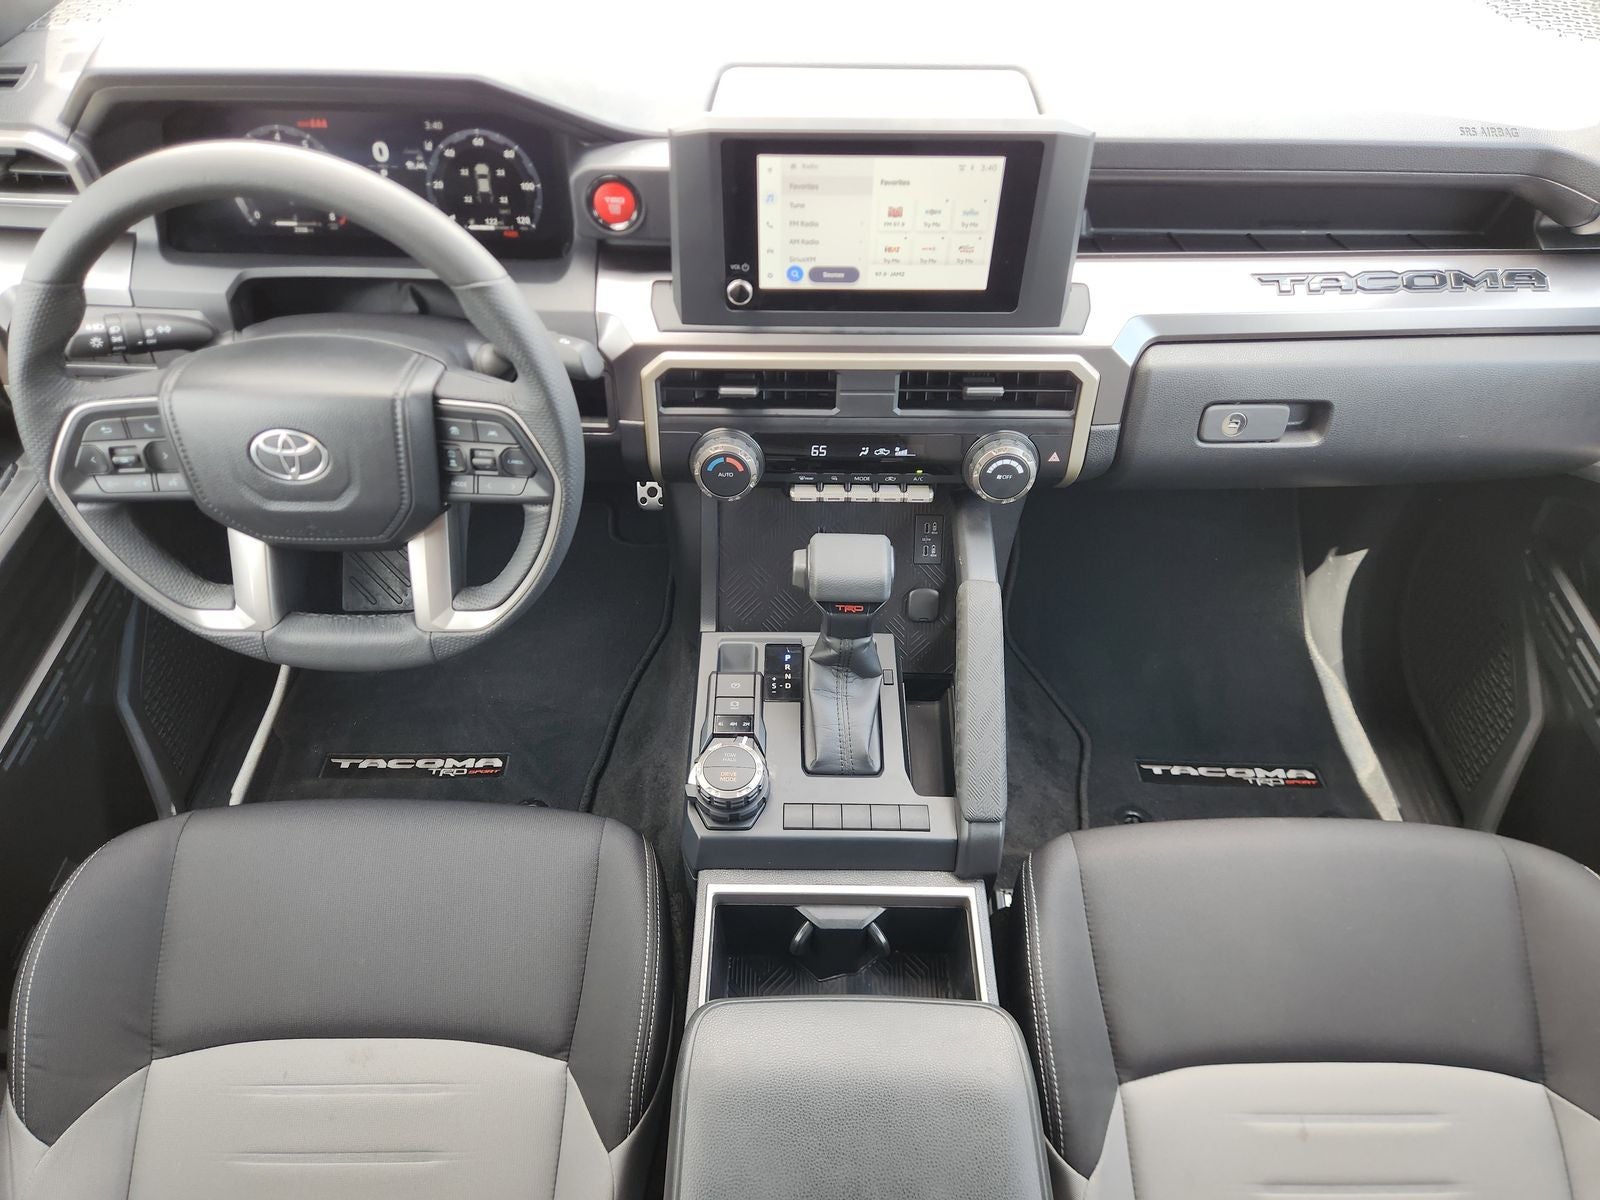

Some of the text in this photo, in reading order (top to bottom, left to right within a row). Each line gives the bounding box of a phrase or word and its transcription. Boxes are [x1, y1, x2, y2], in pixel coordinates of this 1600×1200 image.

[424, 120, 443, 130] 3:40
[1459, 126, 1519, 138] SRS AIRBAG
[472, 137, 485, 147] 60
[371, 140, 390, 163] 0
[443, 148, 456, 158] 40
[502, 149, 516, 159] 80
[432, 180, 444, 190] 20
[520, 182, 536, 191] 100
[880, 179, 910, 187] Favorites
[515, 216, 531, 225] 120
[789, 220, 819, 228] FM Radio
[1251, 268, 1551, 296] TACOMA
[810, 445, 828, 457] 65
[835, 604, 864, 613] TRD
[784, 654, 792, 662] P
[784, 663, 792, 671] R
[771, 682, 777, 690] S
[331, 757, 503, 769] TACOMA
[428, 768, 501, 777] TRD SPORT
[1140, 764, 1317, 780] TACOMA
[1244, 776, 1285, 788] TRD
